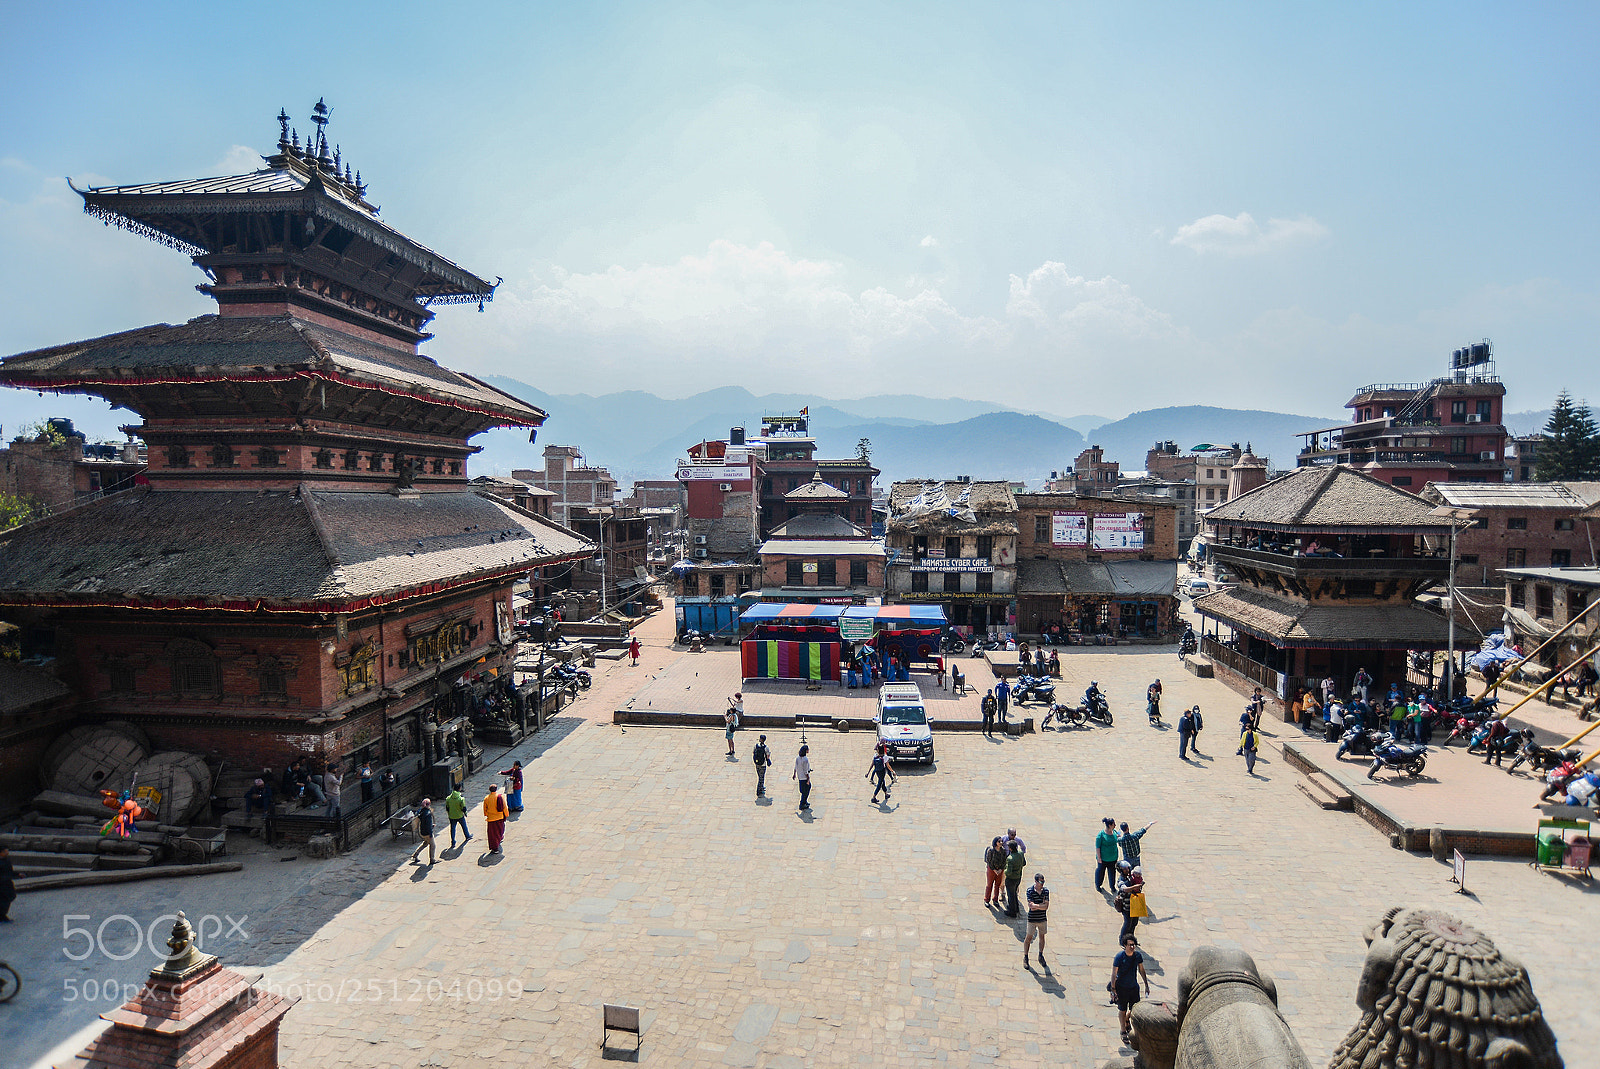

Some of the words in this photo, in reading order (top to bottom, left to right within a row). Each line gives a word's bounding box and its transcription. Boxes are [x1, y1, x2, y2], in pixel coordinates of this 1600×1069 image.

[921, 559, 950, 567] NAMASTE
[951, 559, 971, 567] CYBER
[972, 559, 987, 567] CAFE
